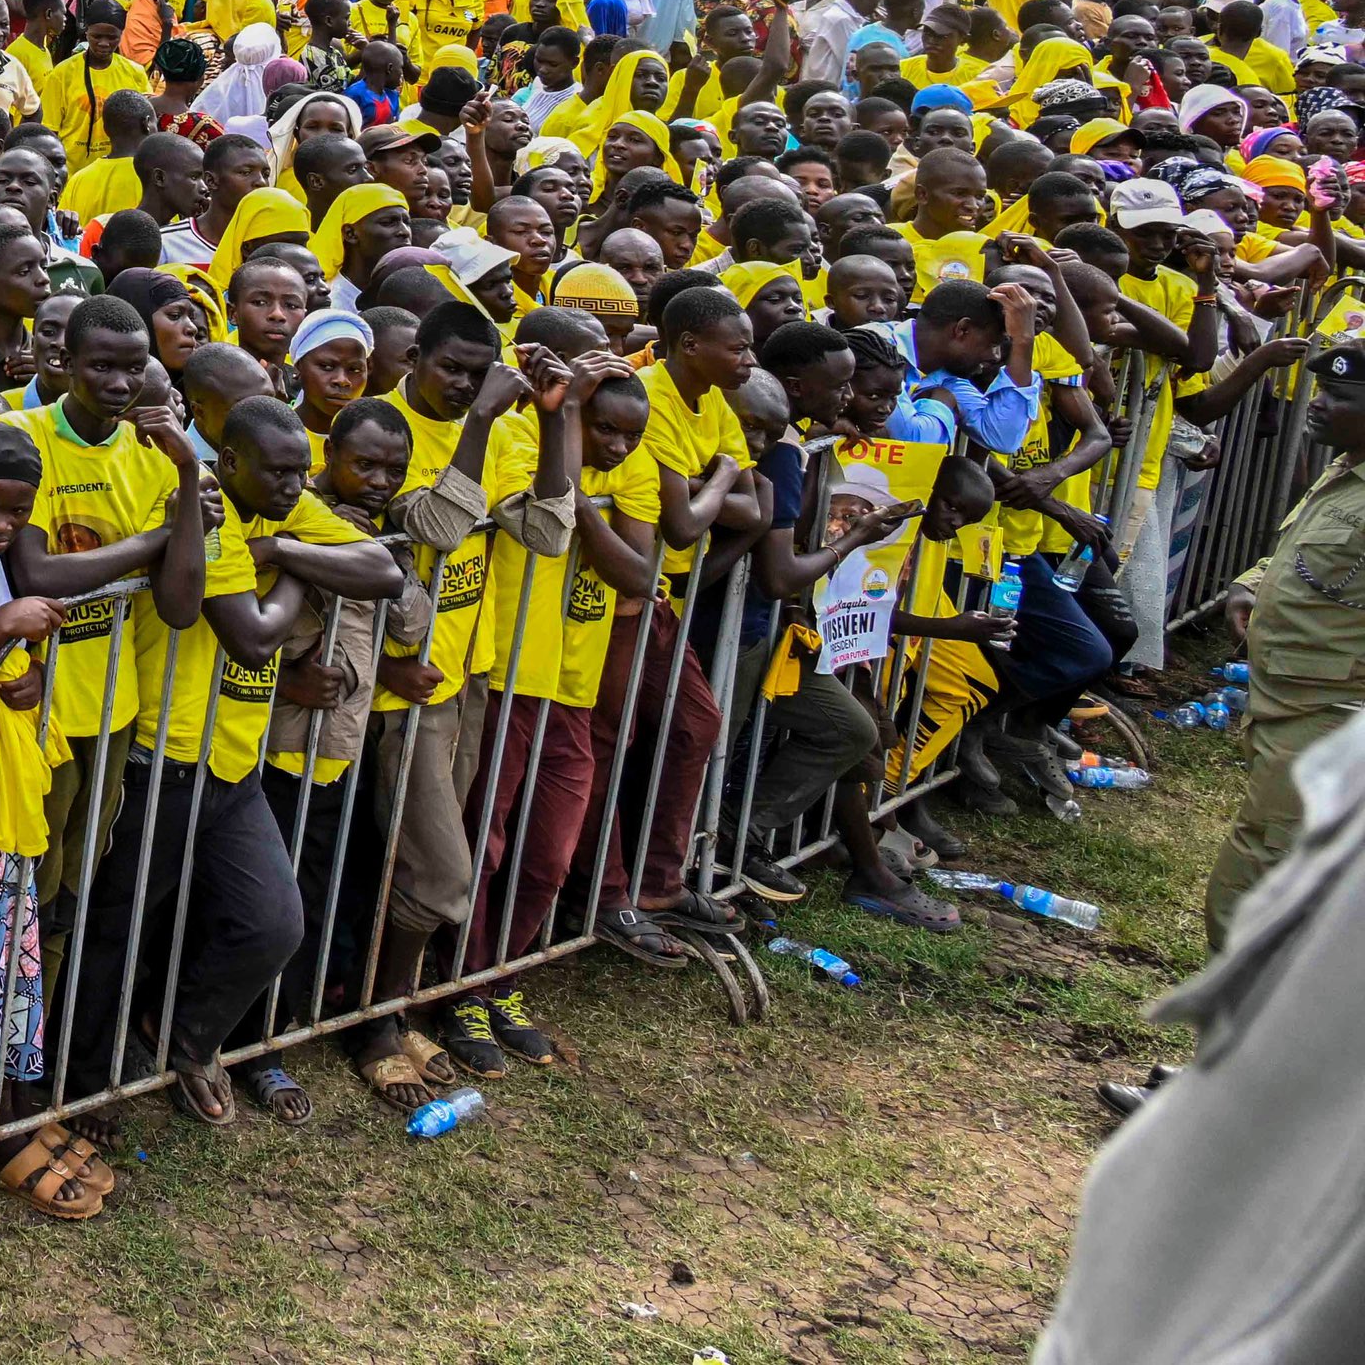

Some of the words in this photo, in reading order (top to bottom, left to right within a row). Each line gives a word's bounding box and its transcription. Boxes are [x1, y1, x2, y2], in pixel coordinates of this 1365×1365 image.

[846, 439, 906, 465] OTE
[56, 483, 104, 495] PRESIDENT
[442, 554, 484, 579] OWERI
[850, 649, 870, 660] FUTURE
